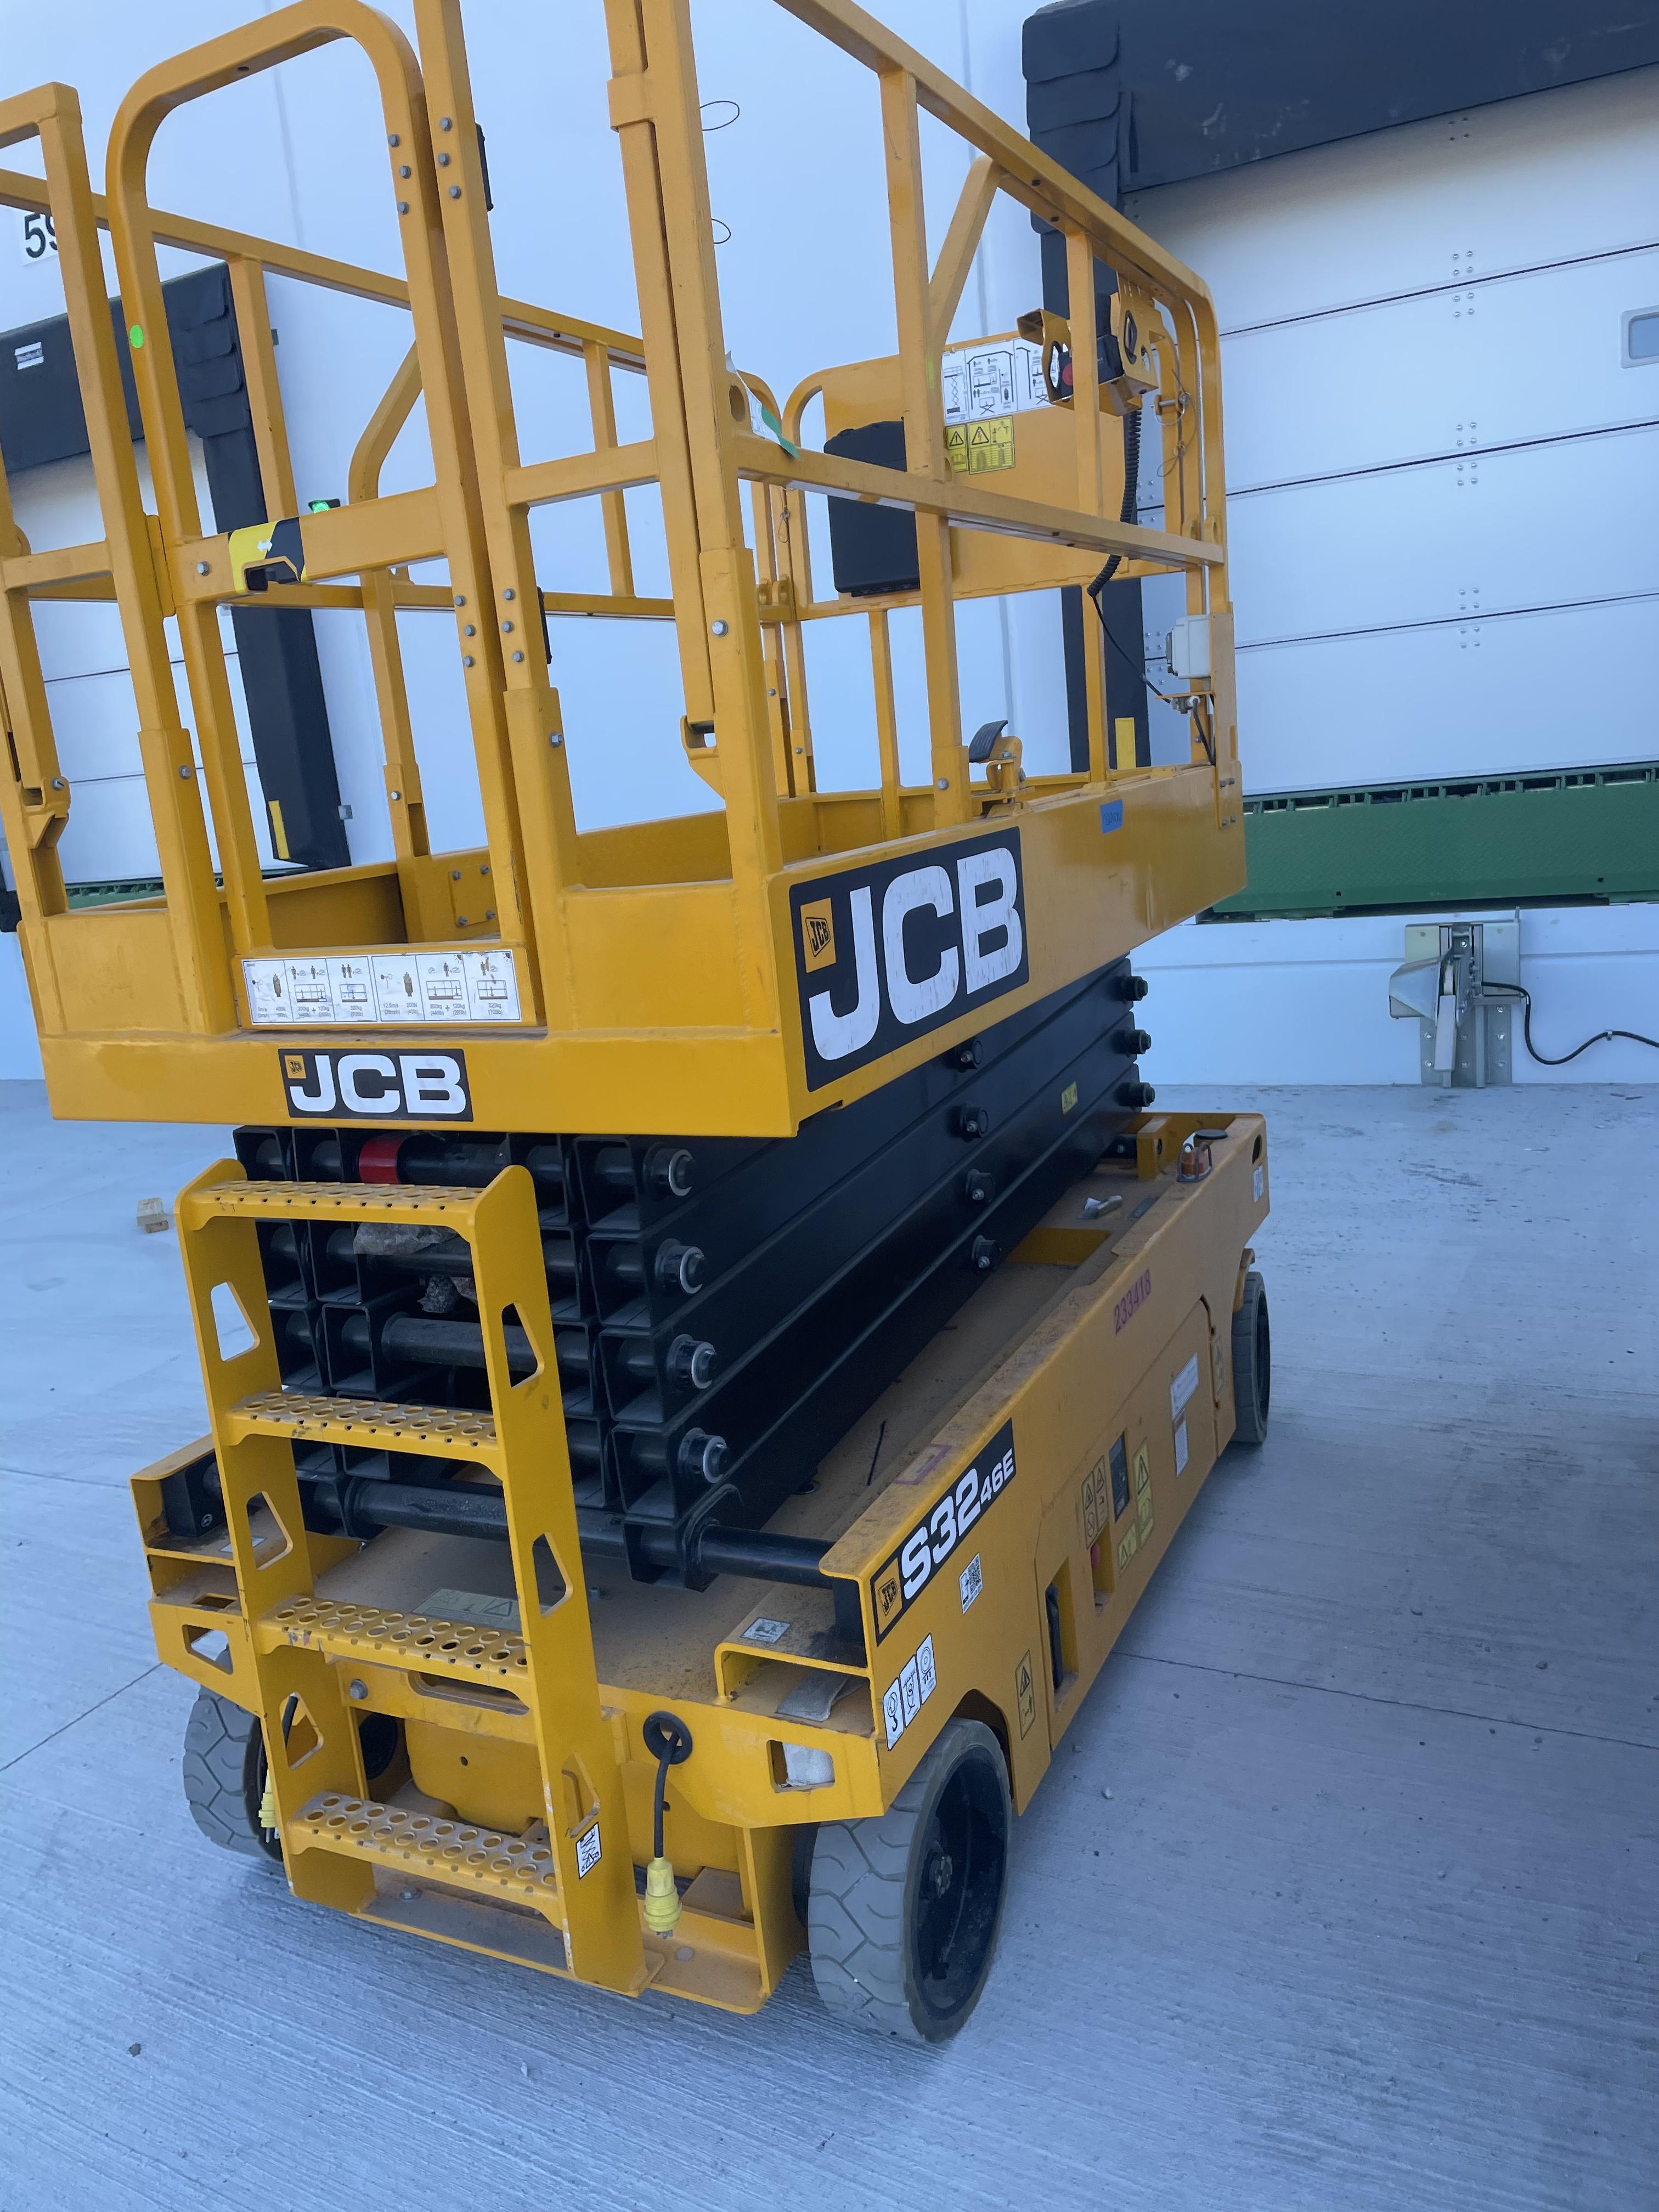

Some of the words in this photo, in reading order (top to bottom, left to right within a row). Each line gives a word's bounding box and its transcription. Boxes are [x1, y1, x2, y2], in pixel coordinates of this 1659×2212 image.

[809, 848, 1023, 1060] JCB
[810, 921, 829, 952] JCB
[289, 1054, 466, 1114] JCB
[1114, 1268, 1151, 1335] 233418
[901, 1468, 981, 1599] S32
[980, 1448, 1015, 1505] 46E
[882, 1581, 896, 1612] JCB
